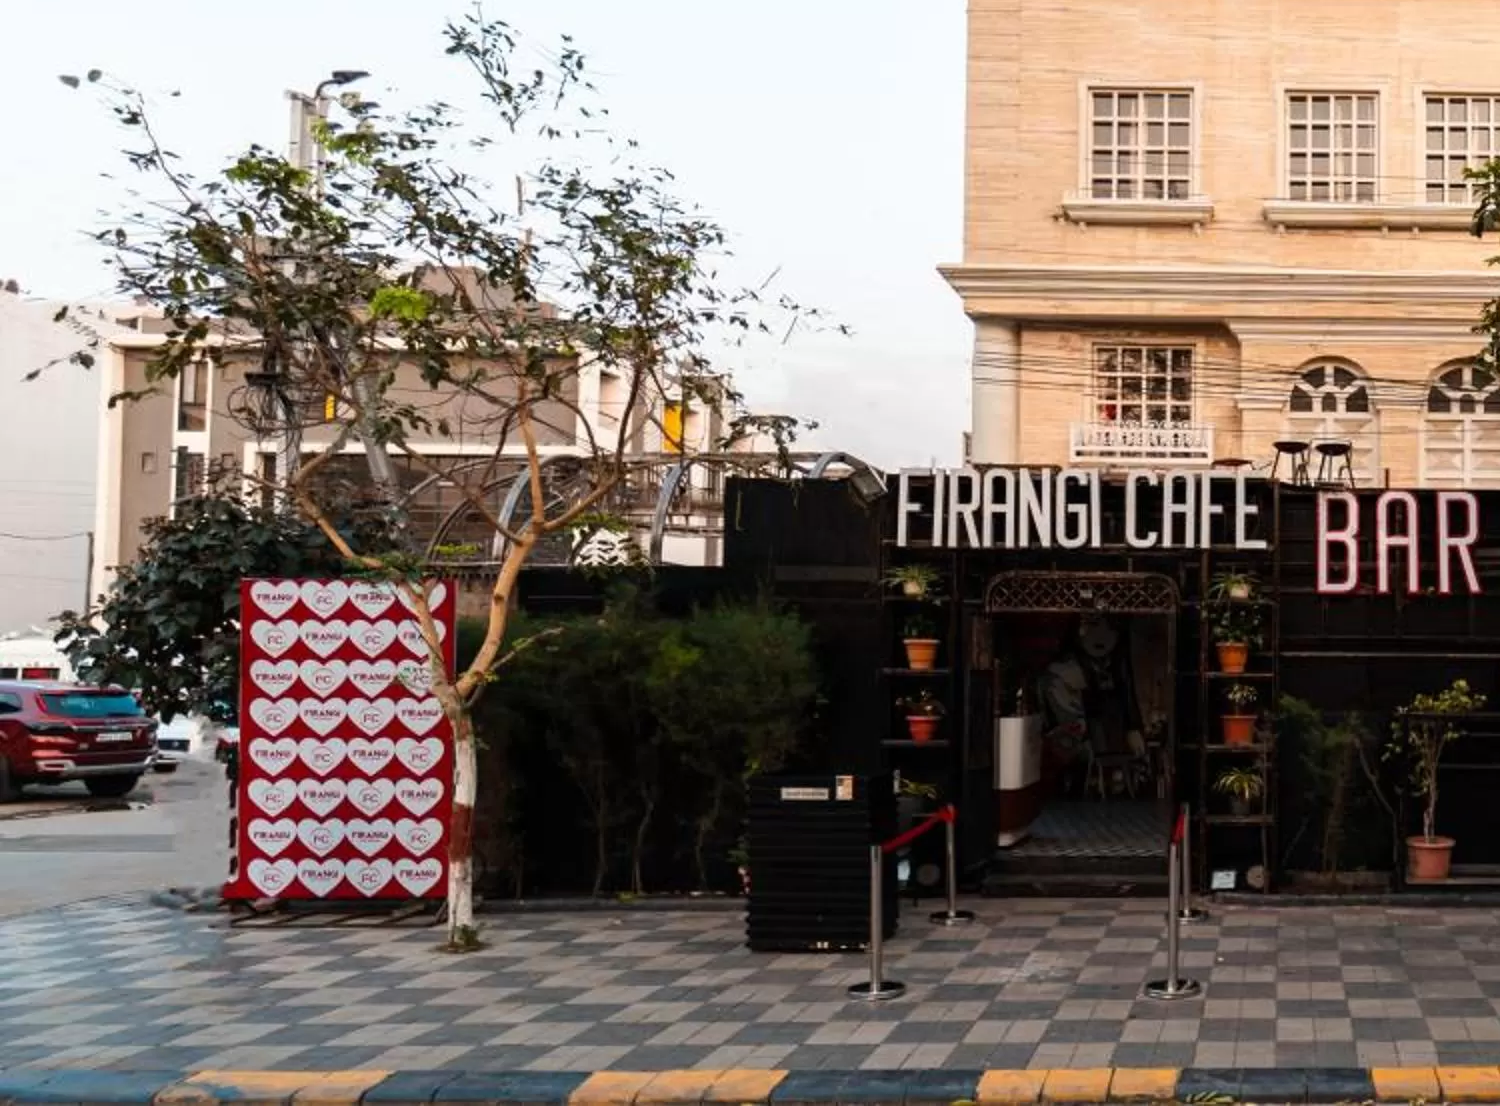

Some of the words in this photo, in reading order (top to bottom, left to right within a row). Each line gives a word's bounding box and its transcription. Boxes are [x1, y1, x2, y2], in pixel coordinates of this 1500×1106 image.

[897, 467, 1100, 549] FIRANGI
[1125, 467, 1268, 550] CAFE
[1315, 490, 1482, 594] BAR
